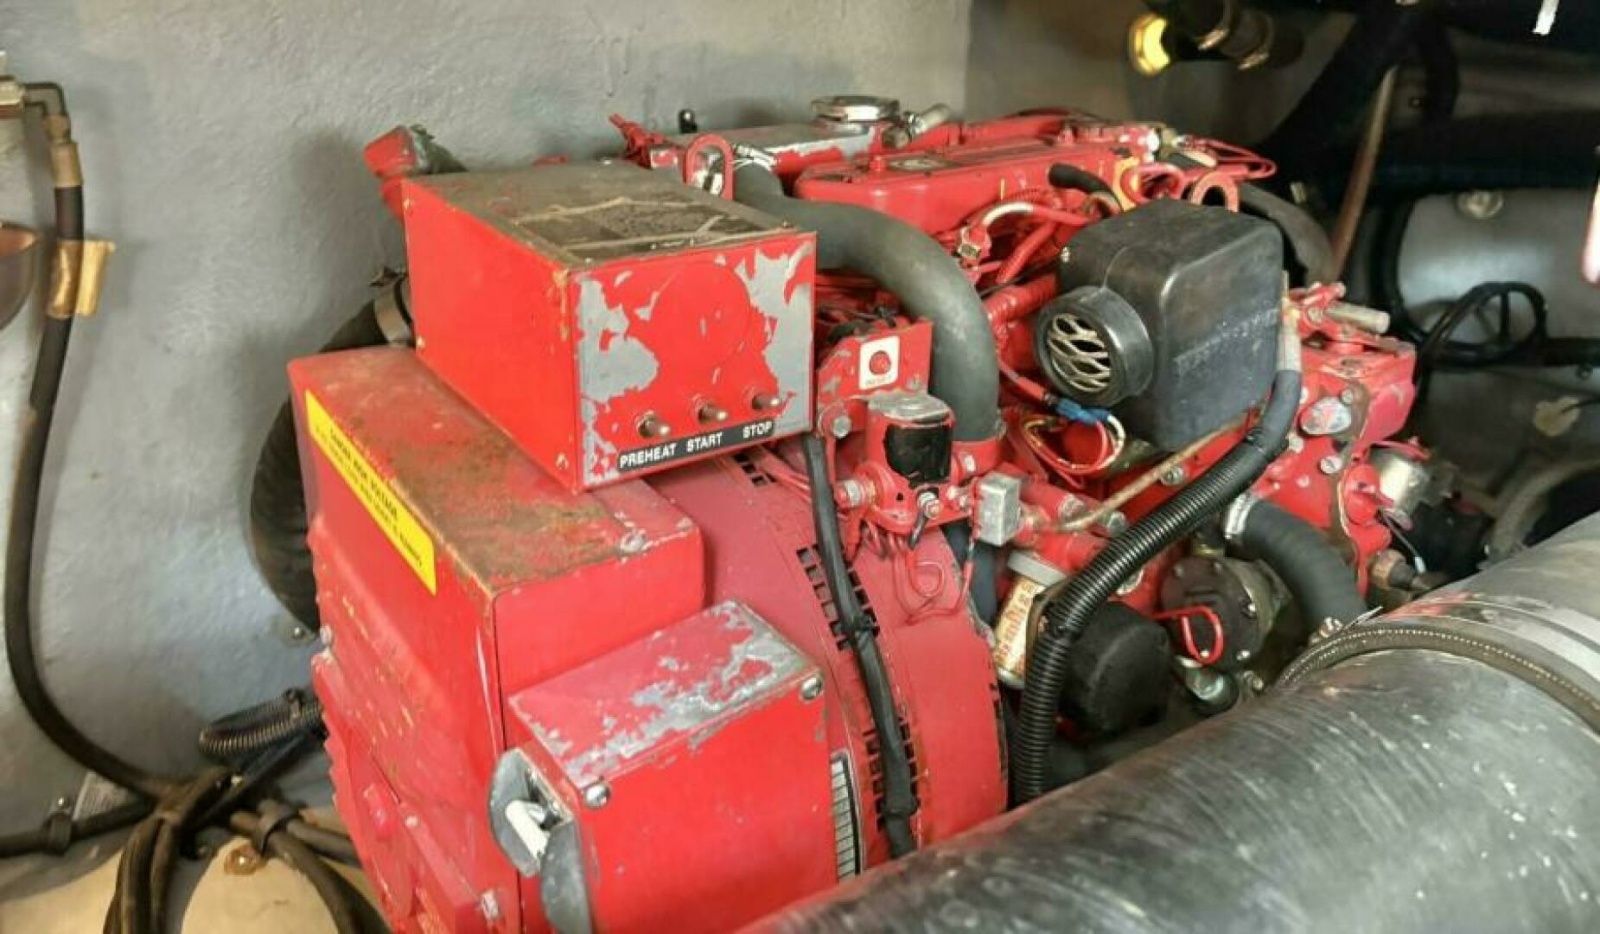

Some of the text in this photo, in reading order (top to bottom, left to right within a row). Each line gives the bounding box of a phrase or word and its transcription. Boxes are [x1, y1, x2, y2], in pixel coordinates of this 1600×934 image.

[619, 421, 773, 469] PREHEAT START STOP
